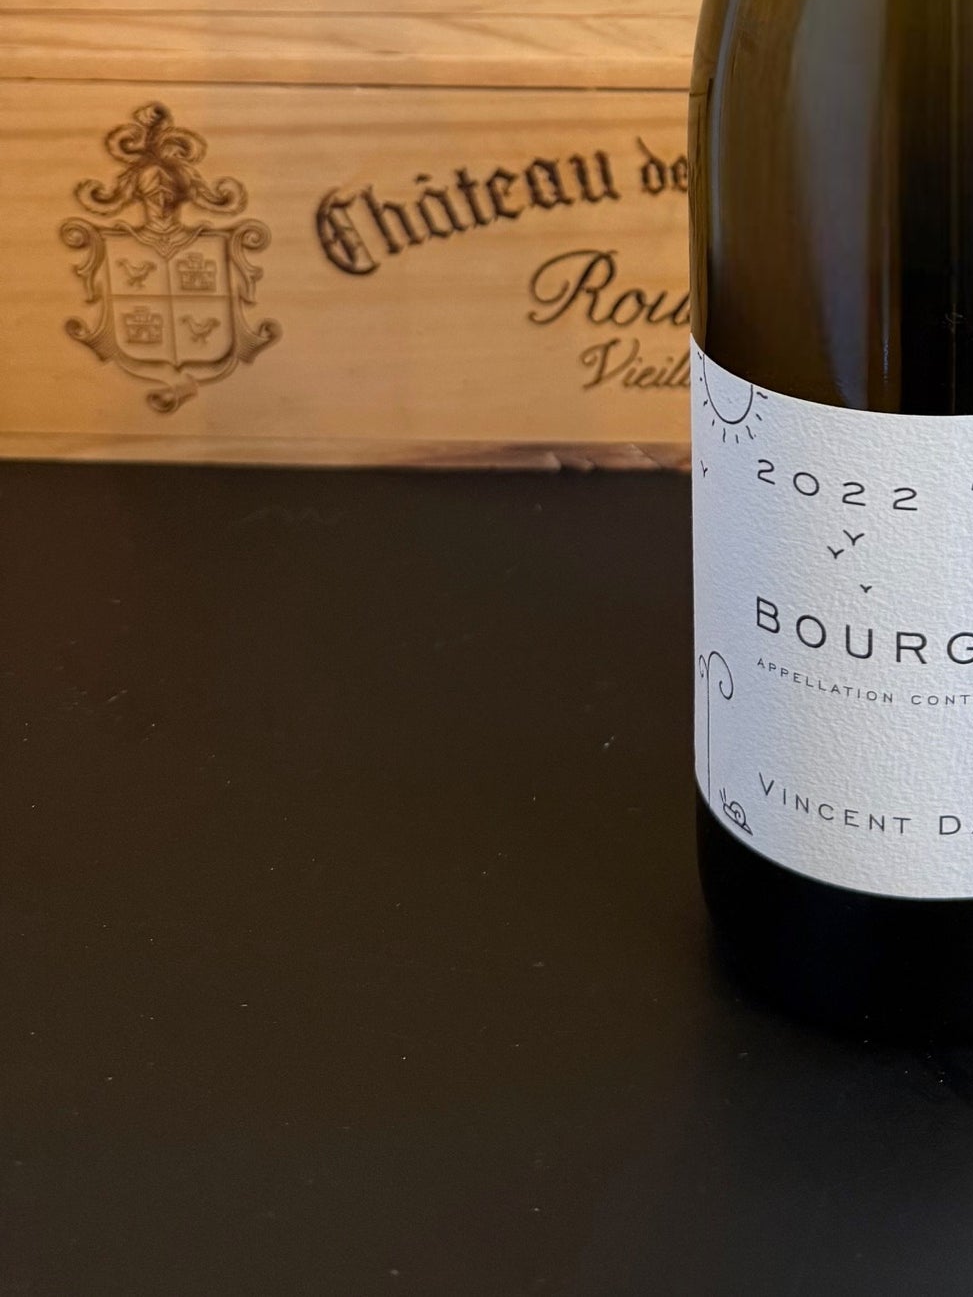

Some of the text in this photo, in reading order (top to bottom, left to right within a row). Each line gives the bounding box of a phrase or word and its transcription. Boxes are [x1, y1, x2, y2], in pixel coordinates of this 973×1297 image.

[314, 135, 689, 278] Château de
[756, 458, 919, 512] 2022
[756, 656, 894, 704] APPELLATION
[758, 771, 912, 835] VINCENT
